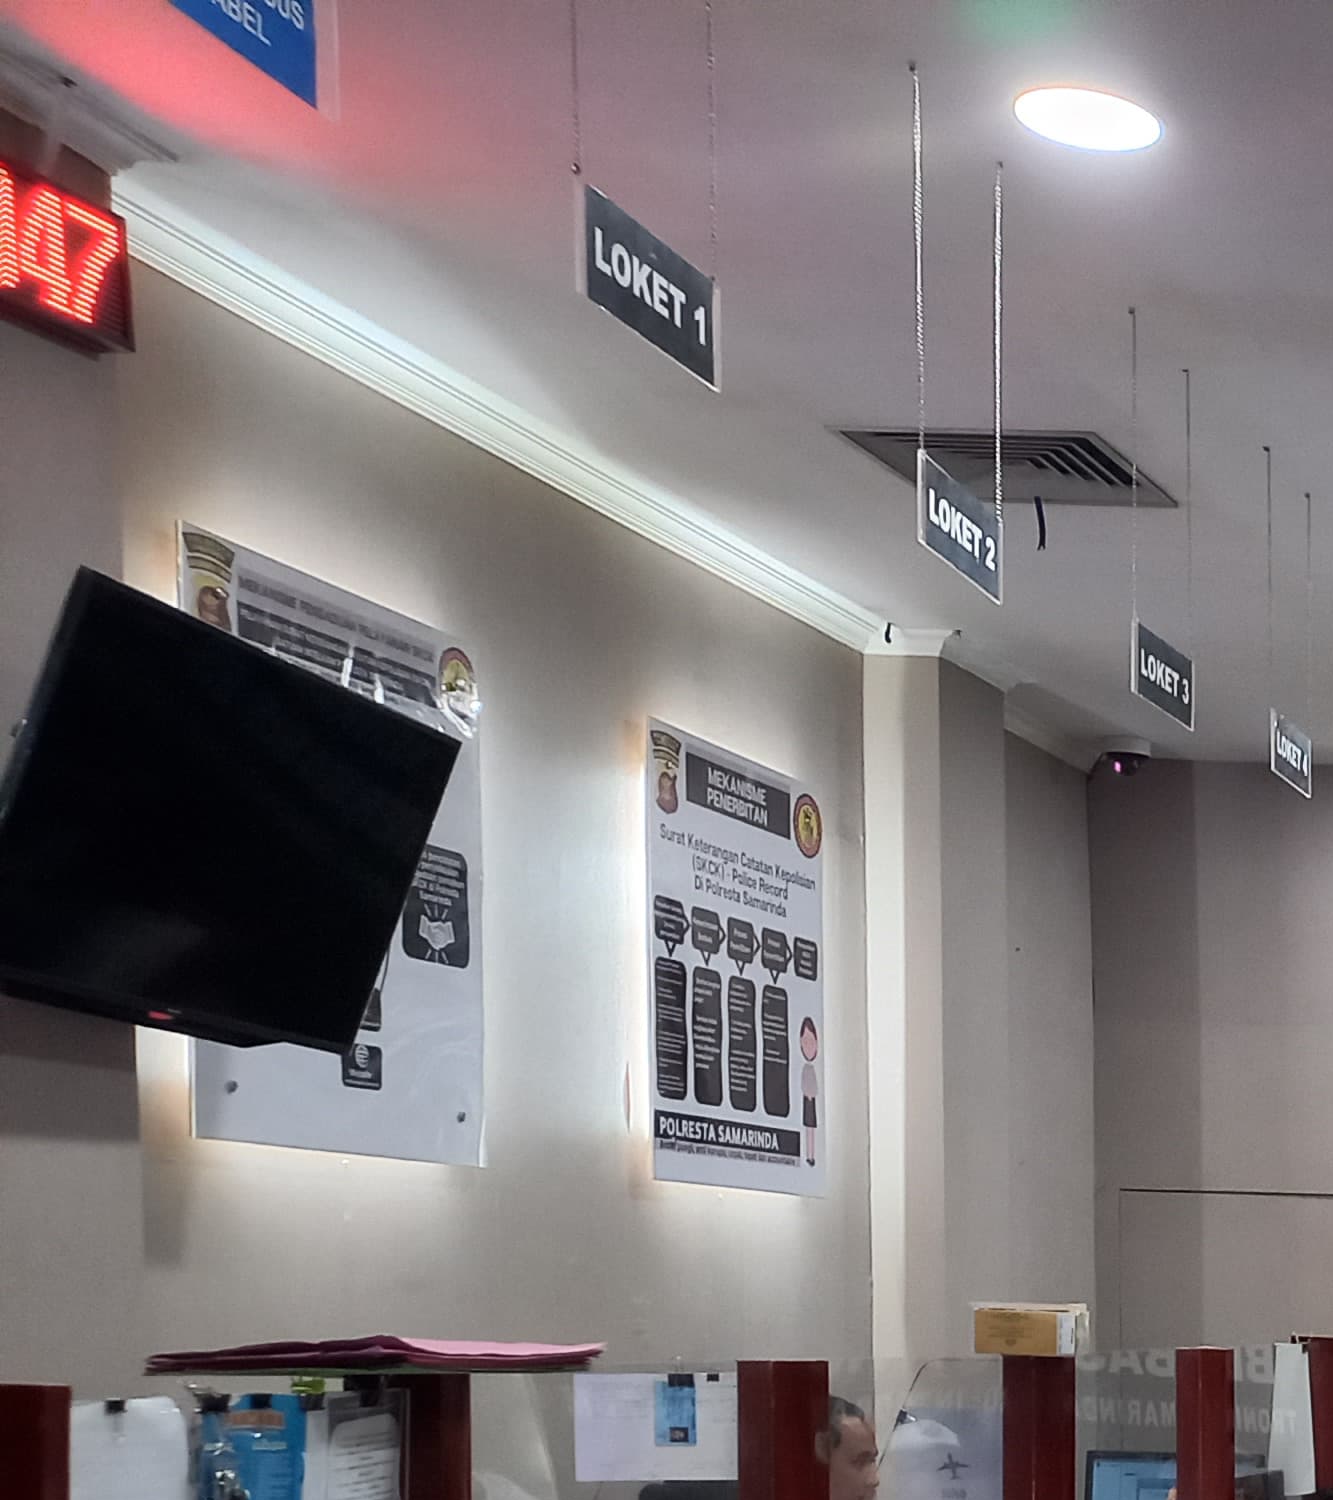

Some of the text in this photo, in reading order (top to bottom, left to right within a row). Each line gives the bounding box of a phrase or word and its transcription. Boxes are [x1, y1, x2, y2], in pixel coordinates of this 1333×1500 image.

[595, 226, 706, 346] LOKET 1
[928, 487, 996, 571] LOKET 2
[1141, 648, 1189, 704] LOKET 3
[1276, 728, 1302, 771] LOKET
[706, 788, 769, 827] PENERBITAN
[707, 767, 767, 806] MEKANISME
[660, 823, 816, 890] Surat Keterangan Catatan Kepolisian
[705, 877, 742, 903] Polresta
[743, 890, 787, 918] Samarinda
[732, 868, 757, 889] Police
[759, 877, 789, 899] Record
[659, 1116, 780, 1151] POLRESTA SAMARINDA
